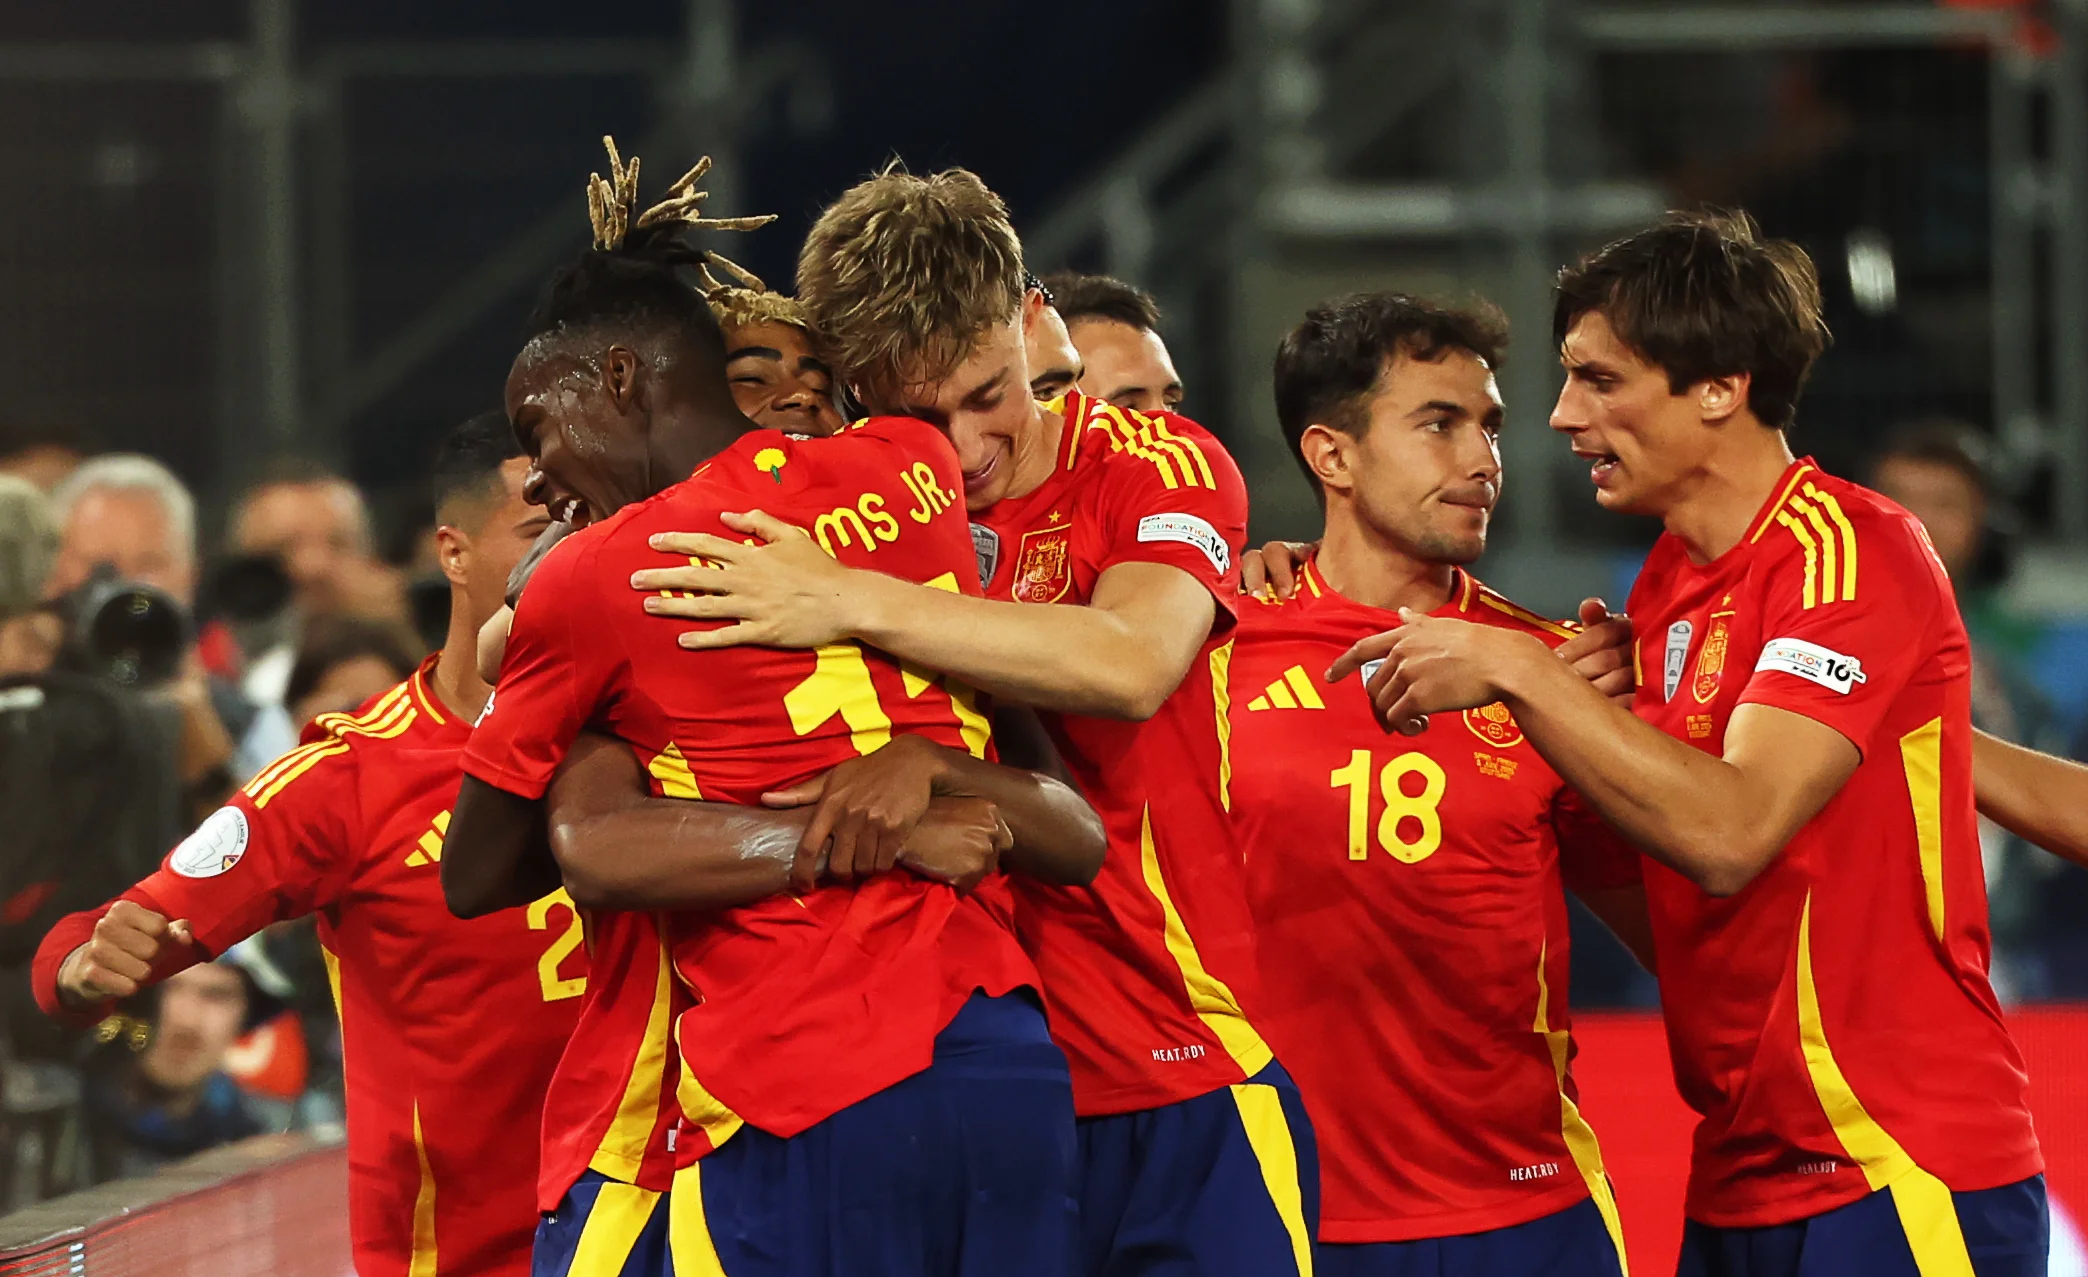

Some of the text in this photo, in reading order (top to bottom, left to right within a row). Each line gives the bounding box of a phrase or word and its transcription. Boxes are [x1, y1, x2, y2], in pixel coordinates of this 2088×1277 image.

[900, 462, 957, 524] JR.
[1330, 749, 1447, 865] 18
[1151, 1044, 1206, 1062] HEAT.RDY
[1510, 1161, 1560, 1181] HEAT.RDY
